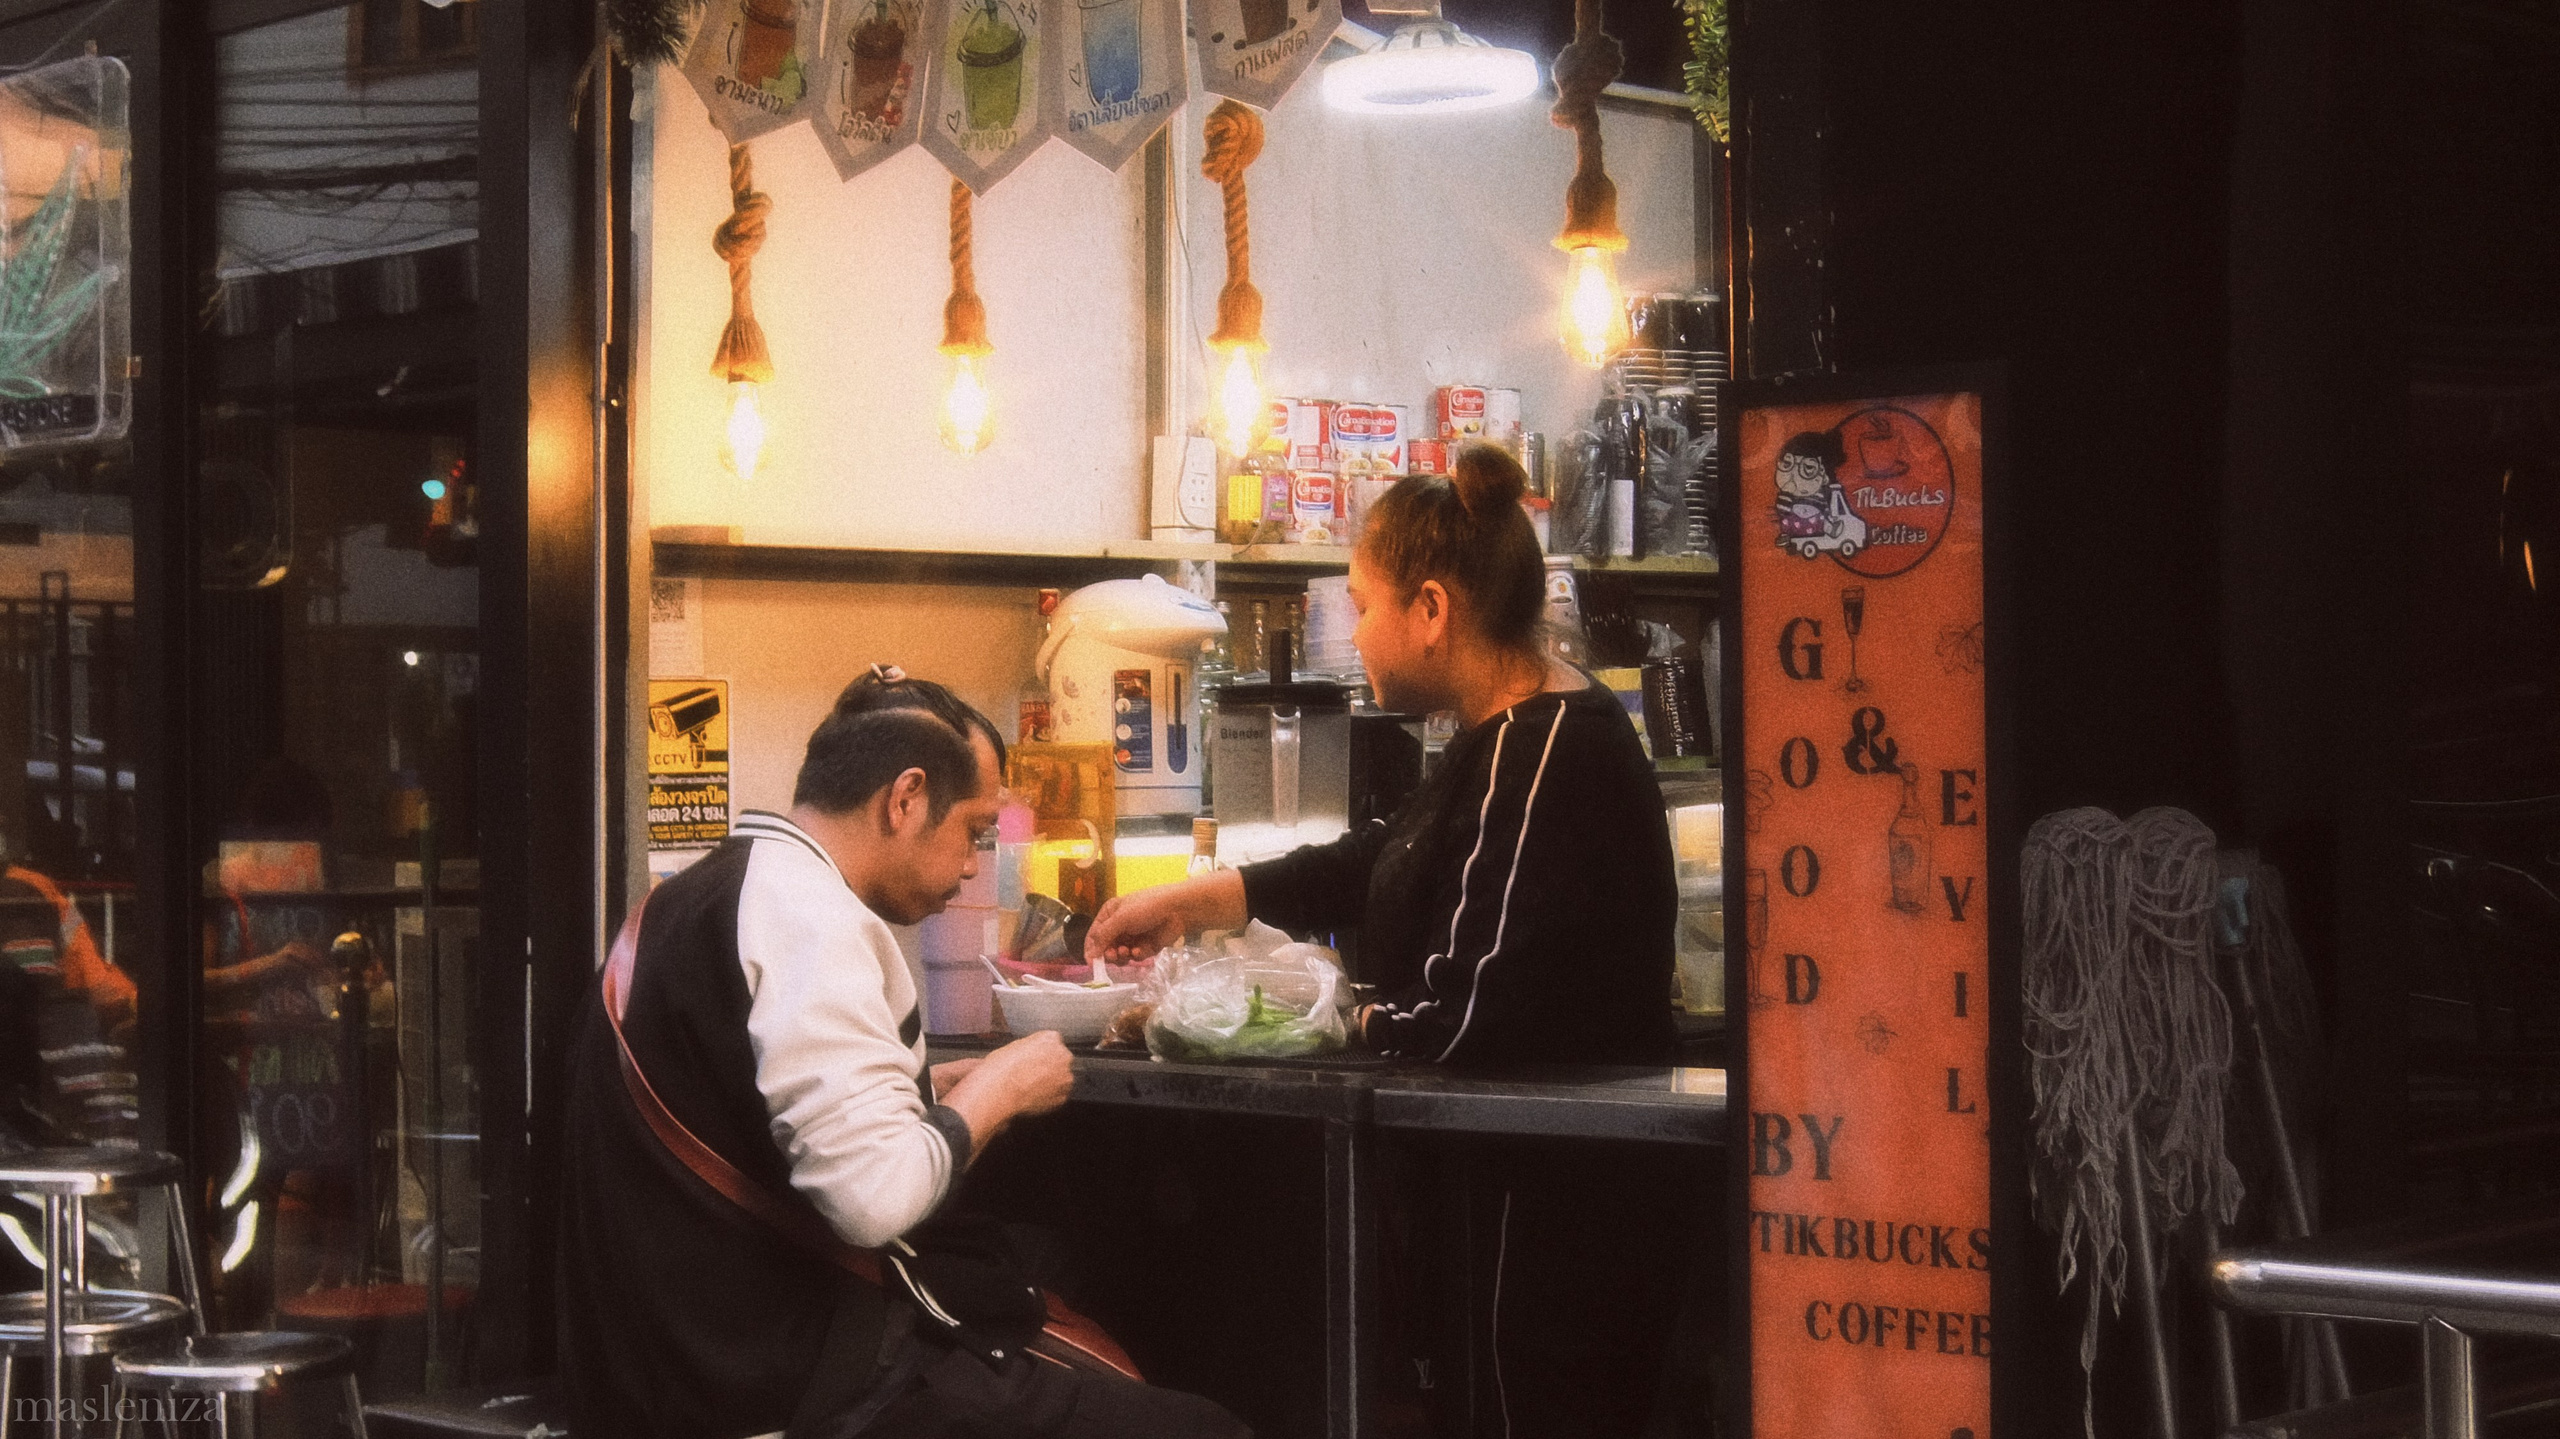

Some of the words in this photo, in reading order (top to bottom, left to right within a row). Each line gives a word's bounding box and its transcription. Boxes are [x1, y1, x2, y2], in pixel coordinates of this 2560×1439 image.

[1871, 525, 1928, 545] Coffee
[1220, 727, 1265, 740] Blender
[1843, 706, 1903, 774] &
[654, 753, 687, 766] CCTV
[649, 785, 728, 806] ล้องวงจรปิด
[682, 806, 701, 822] 24
[1751, 1111, 1844, 1181] BY
[1751, 1210, 1991, 1272] TIKBUCKS
